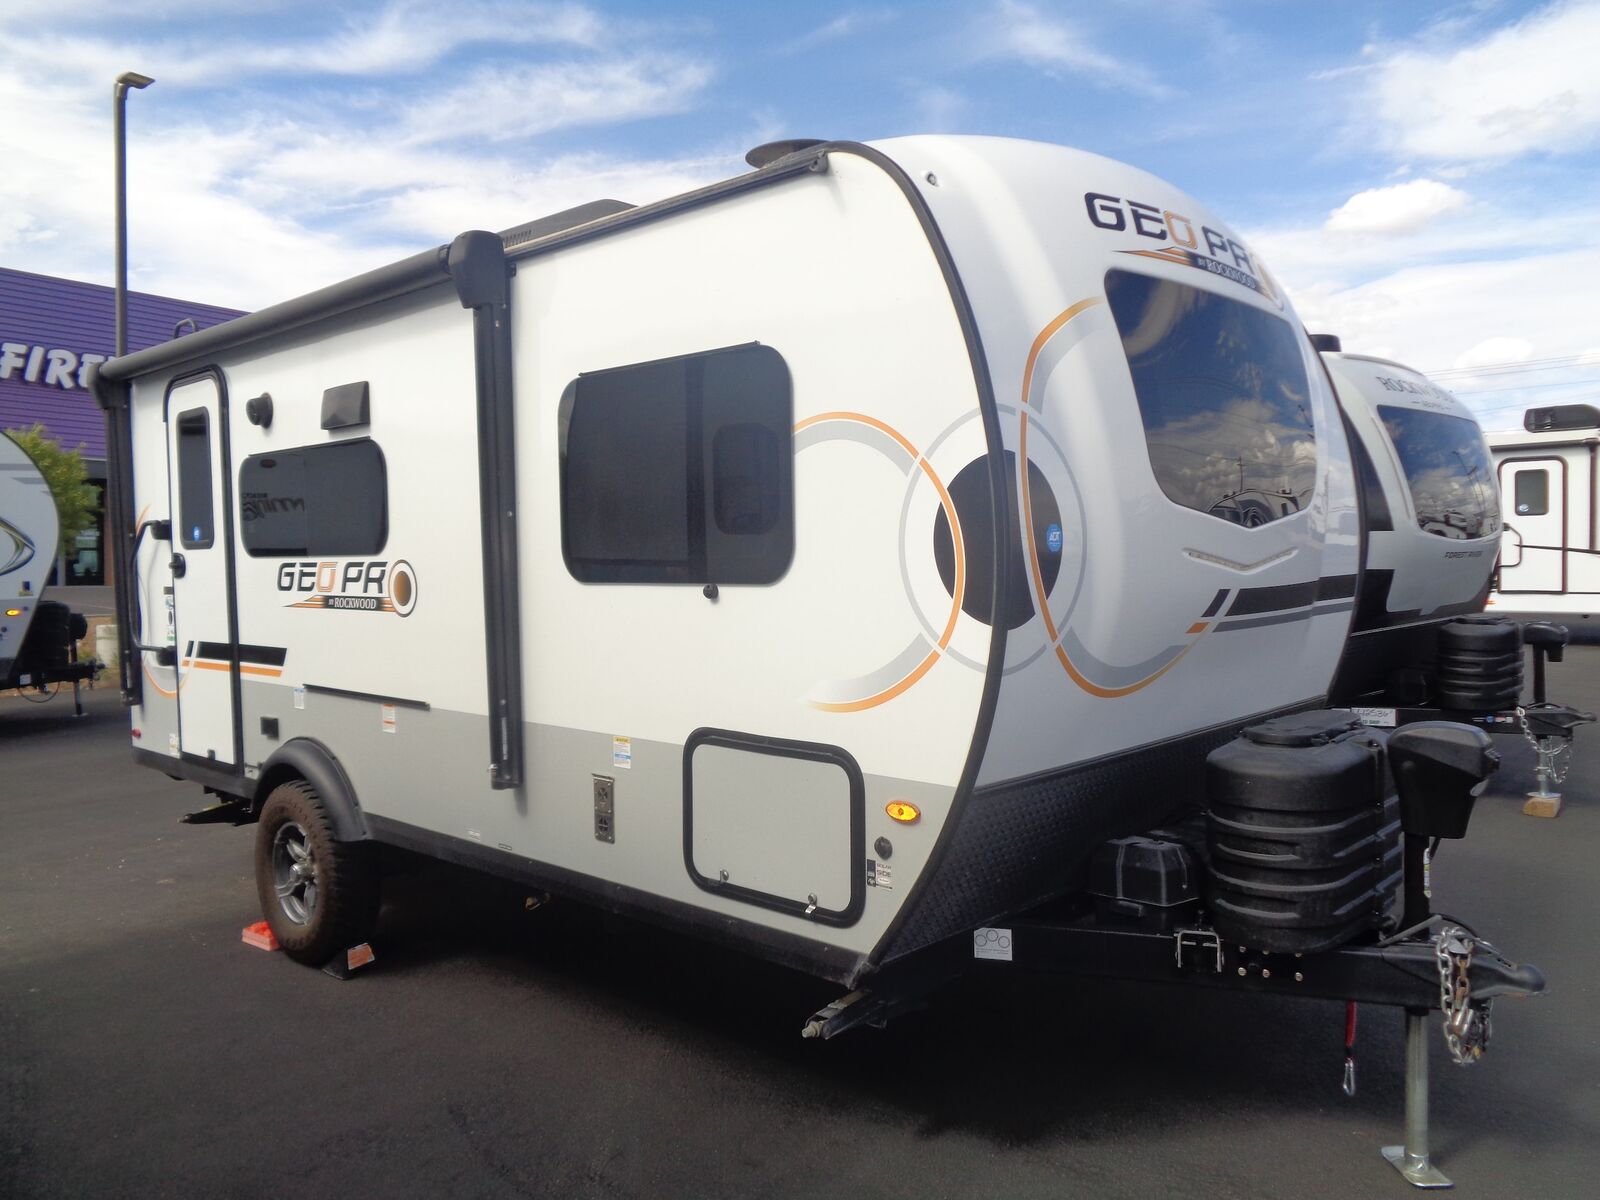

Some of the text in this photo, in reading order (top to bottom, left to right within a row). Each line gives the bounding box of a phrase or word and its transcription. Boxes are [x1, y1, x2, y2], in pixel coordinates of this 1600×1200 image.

[1084, 192, 1198, 249] GEO
[277, 561, 338, 592] GEO
[334, 597, 377, 609] ROCKWOOD
